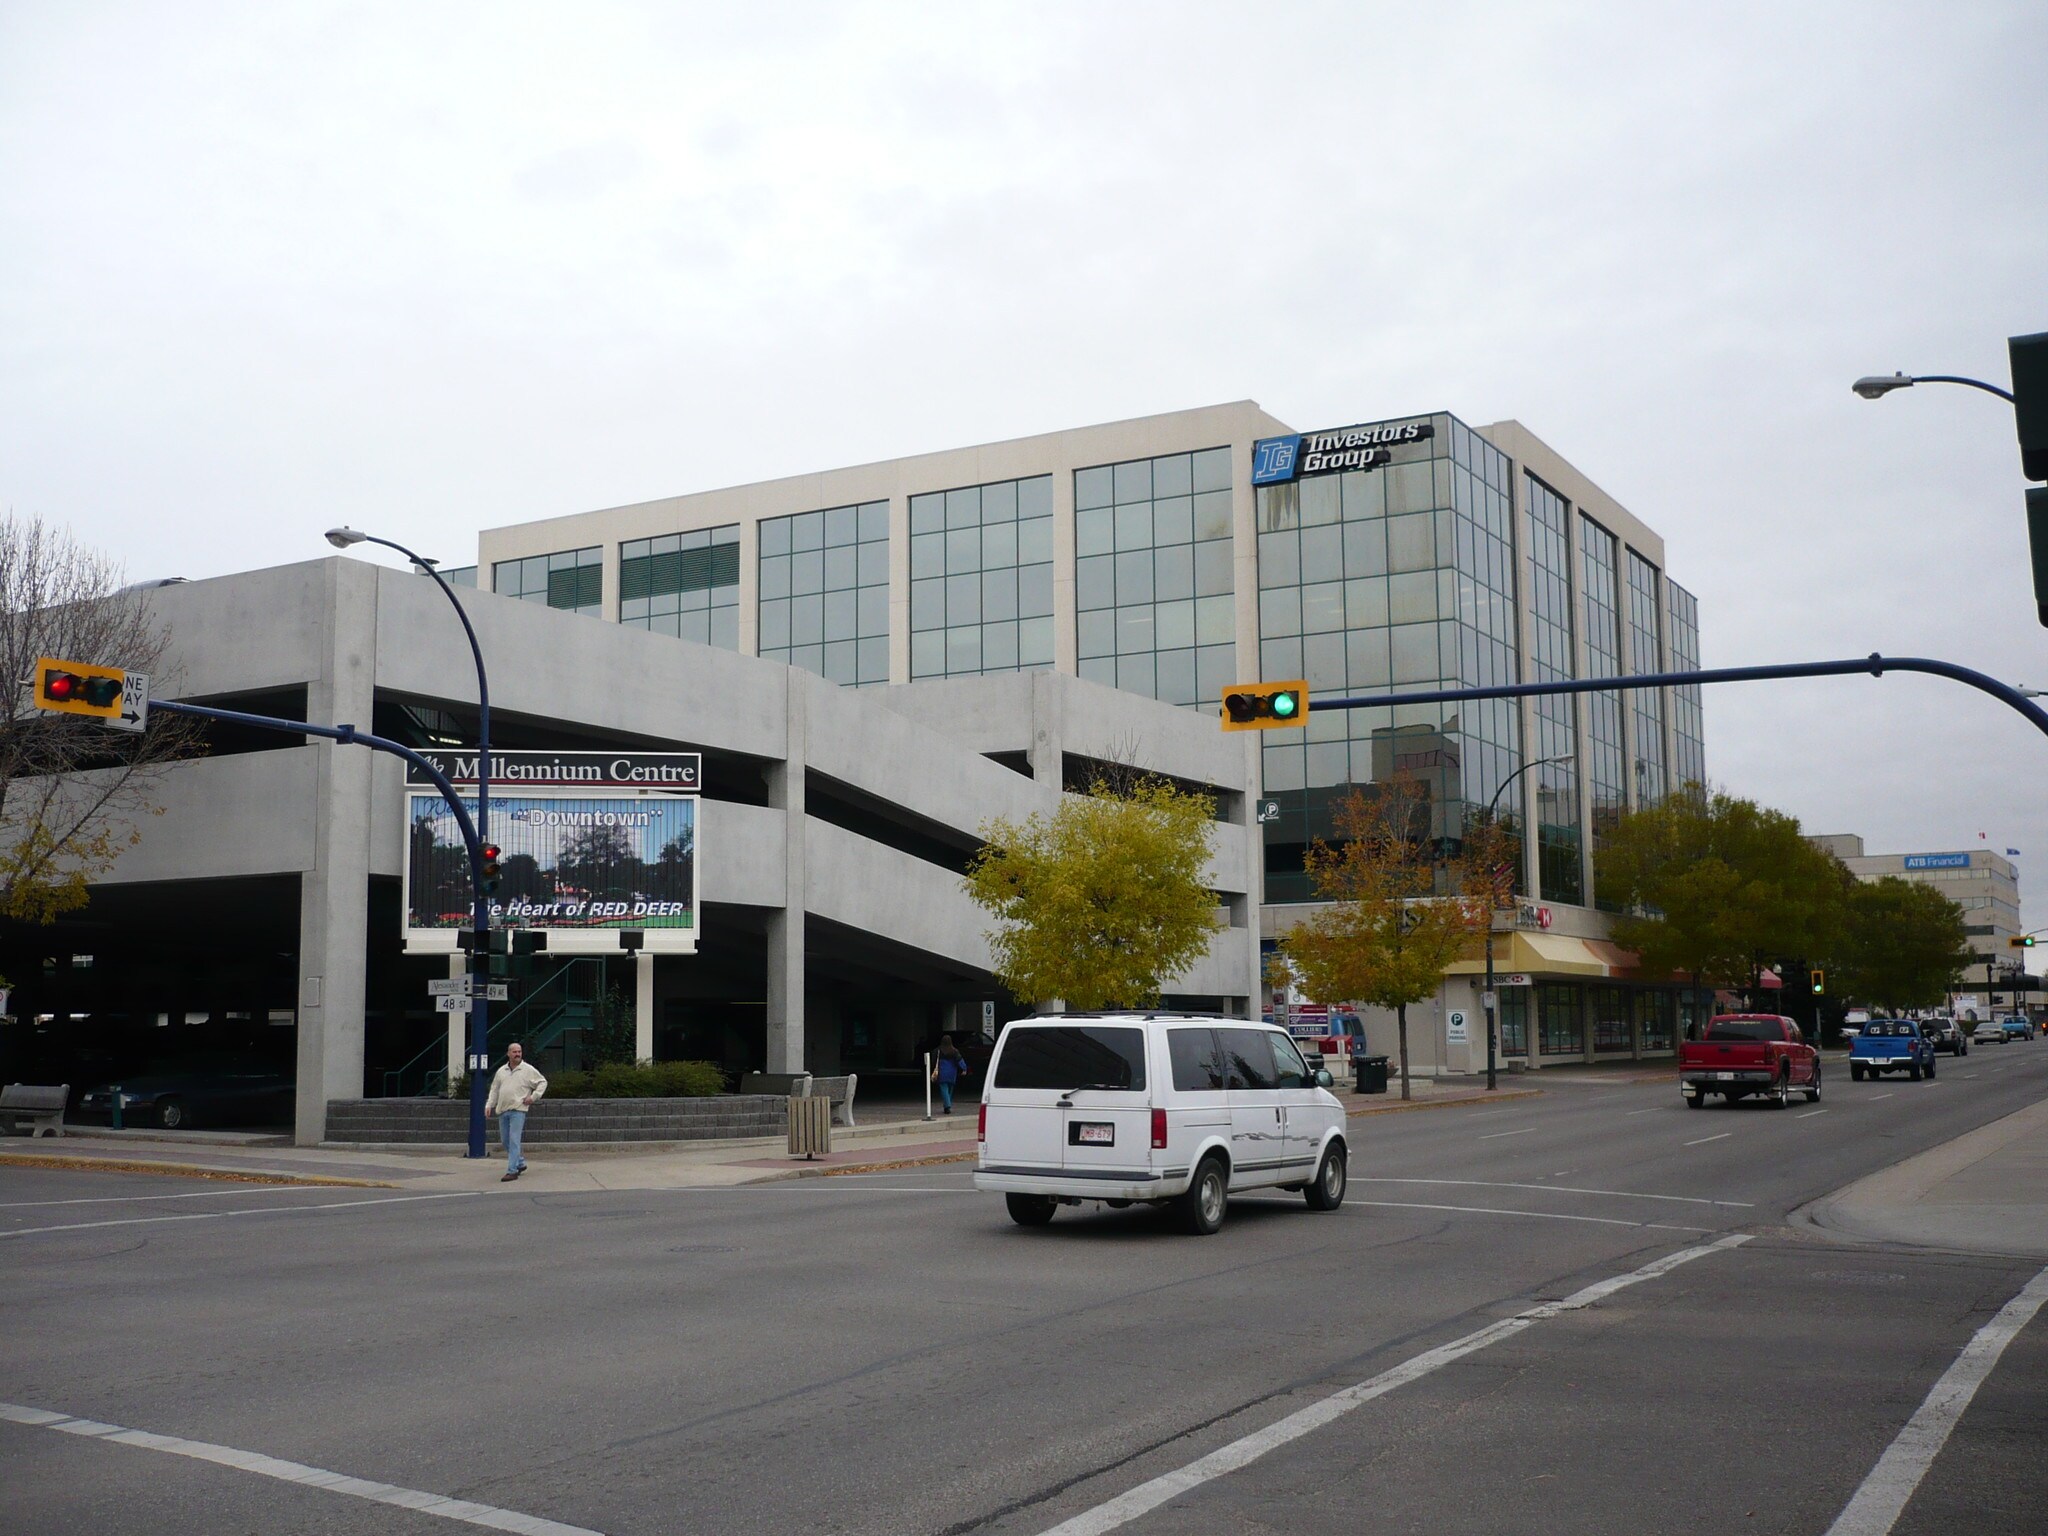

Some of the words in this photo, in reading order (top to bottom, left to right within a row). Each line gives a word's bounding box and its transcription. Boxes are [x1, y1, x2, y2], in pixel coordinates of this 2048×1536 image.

[1308, 423, 1419, 453] Investors
[1303, 448, 1375, 472] Group
[125, 675, 143, 691] NE
[123, 691, 143, 707] AY
[452, 757, 603, 782] Mllennium
[609, 759, 695, 783] Centre
[1907, 857, 1927, 868] ATB
[1927, 855, 1965, 866] Financial
[469, 902, 502, 917] Te
[507, 901, 563, 917] Heart
[566, 902, 586, 917] of
[589, 902, 628, 917] RED
[633, 902, 684, 917] DEER
[1493, 975, 1511, 984] SBC
[442, 998, 455, 1010] 48
[459, 1000, 467, 1009] ST
